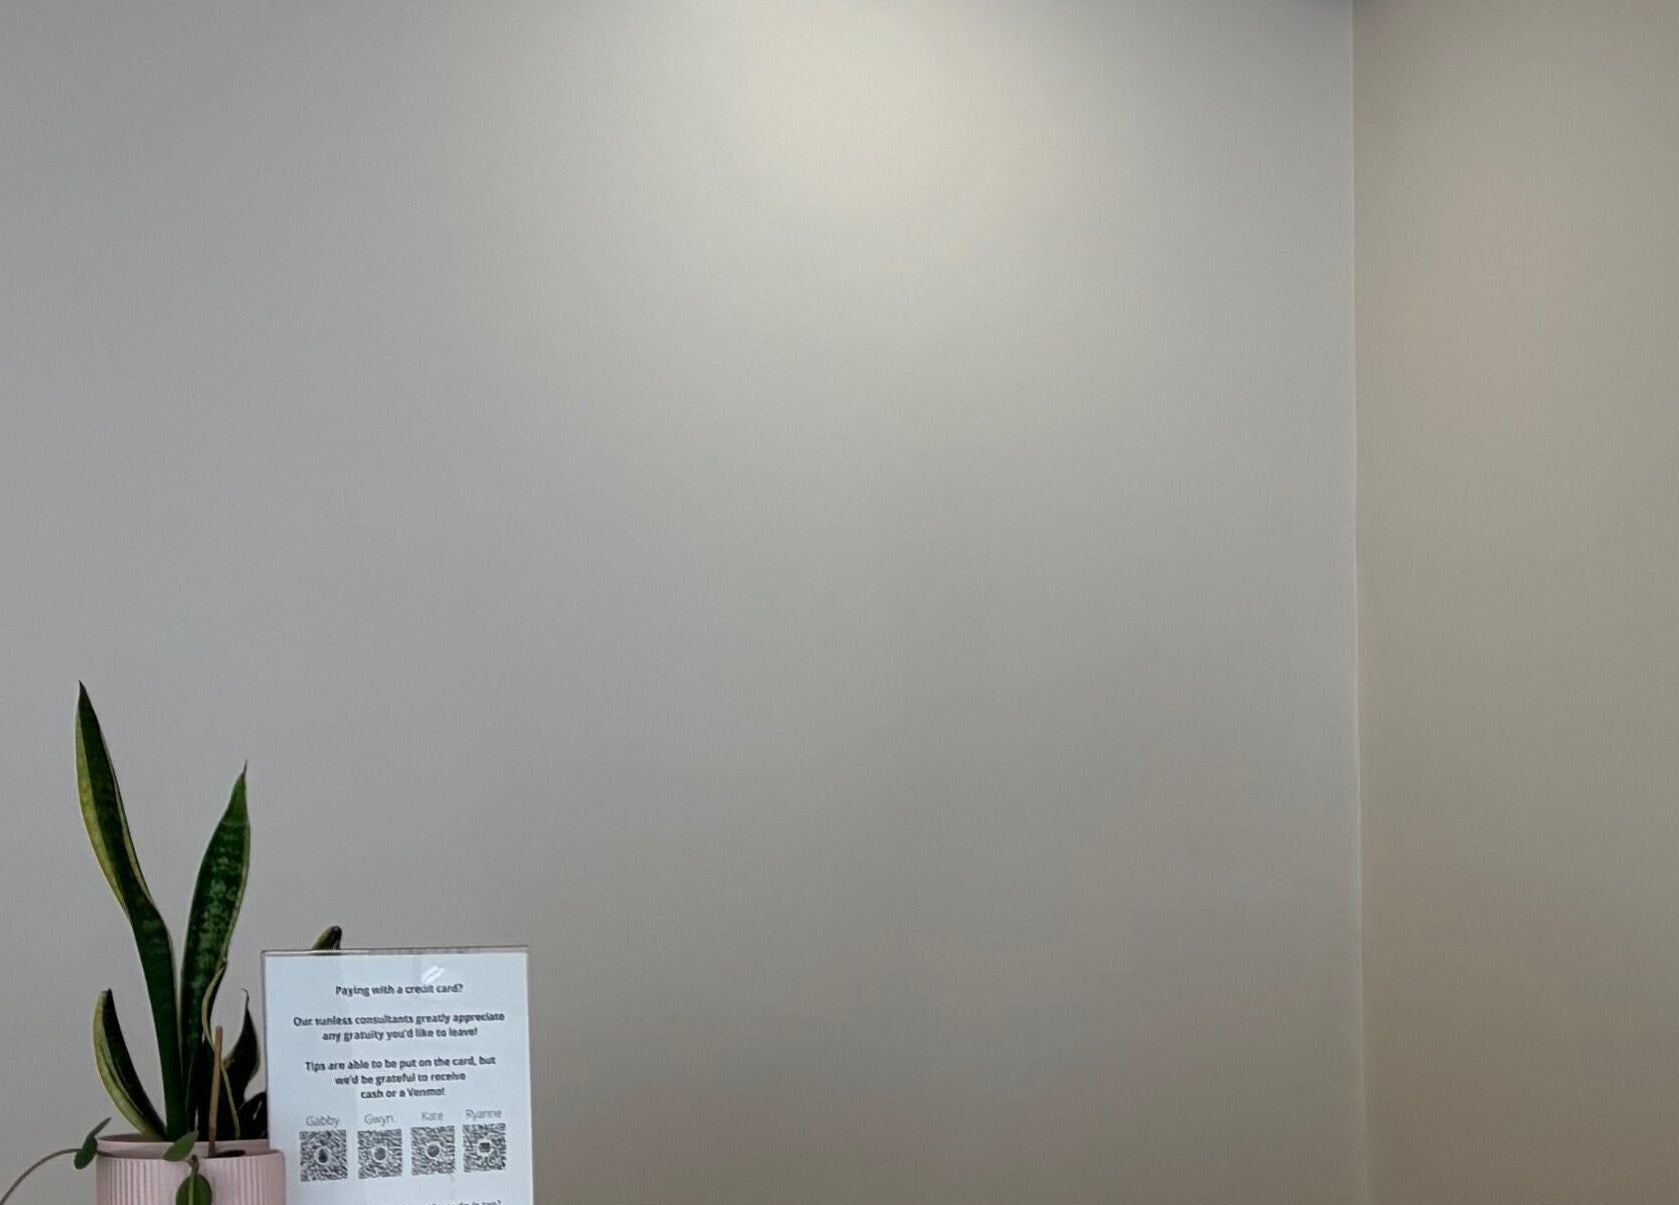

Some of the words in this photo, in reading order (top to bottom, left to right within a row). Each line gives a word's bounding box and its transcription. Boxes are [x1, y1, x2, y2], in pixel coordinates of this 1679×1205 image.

[335, 985, 371, 998] Paying
[371, 984, 395, 995] with
[396, 986, 404, 995] a
[435, 983, 464, 994] card?
[293, 1016, 313, 1027] Our
[354, 1014, 414, 1025] consultants
[415, 1013, 451, 1026] greatly
[305, 1061, 326, 1073] Tips
[327, 1062, 346, 1071] are
[347, 1059, 370, 1070] able
[371, 1060, 383, 1069] to
[384, 1058, 398, 1069] be
[399, 1059, 417, 1070] put
[418, 1059, 433, 1067] on
[433, 1057, 451, 1067] the
[451, 1056, 477, 1066] card,
[478, 1056, 497, 1065] but
